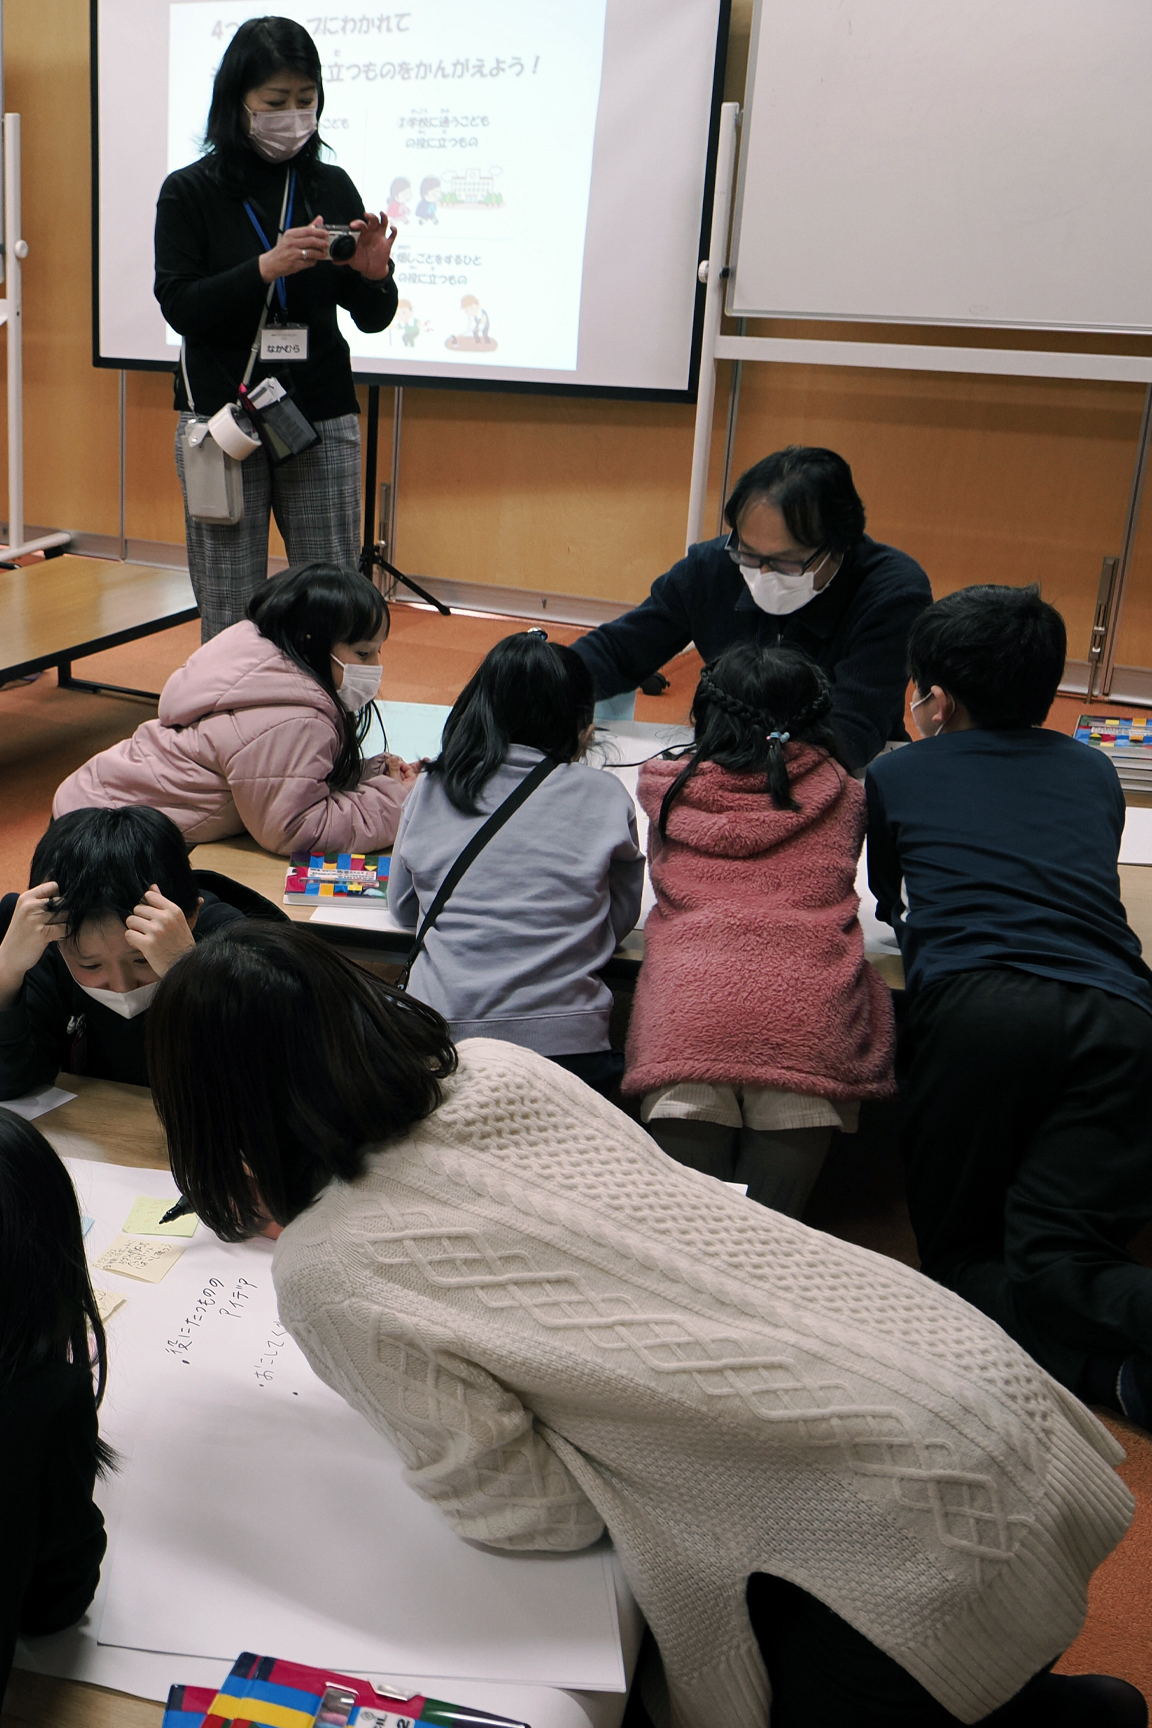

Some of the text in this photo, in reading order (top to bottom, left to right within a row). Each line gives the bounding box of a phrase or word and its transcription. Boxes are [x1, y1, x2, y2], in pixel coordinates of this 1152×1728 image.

[322, 55, 540, 82] 立つものをかんがえよう！
[267, 344, 301, 354] なかむら
[219, 1277, 258, 1319] アイデア
